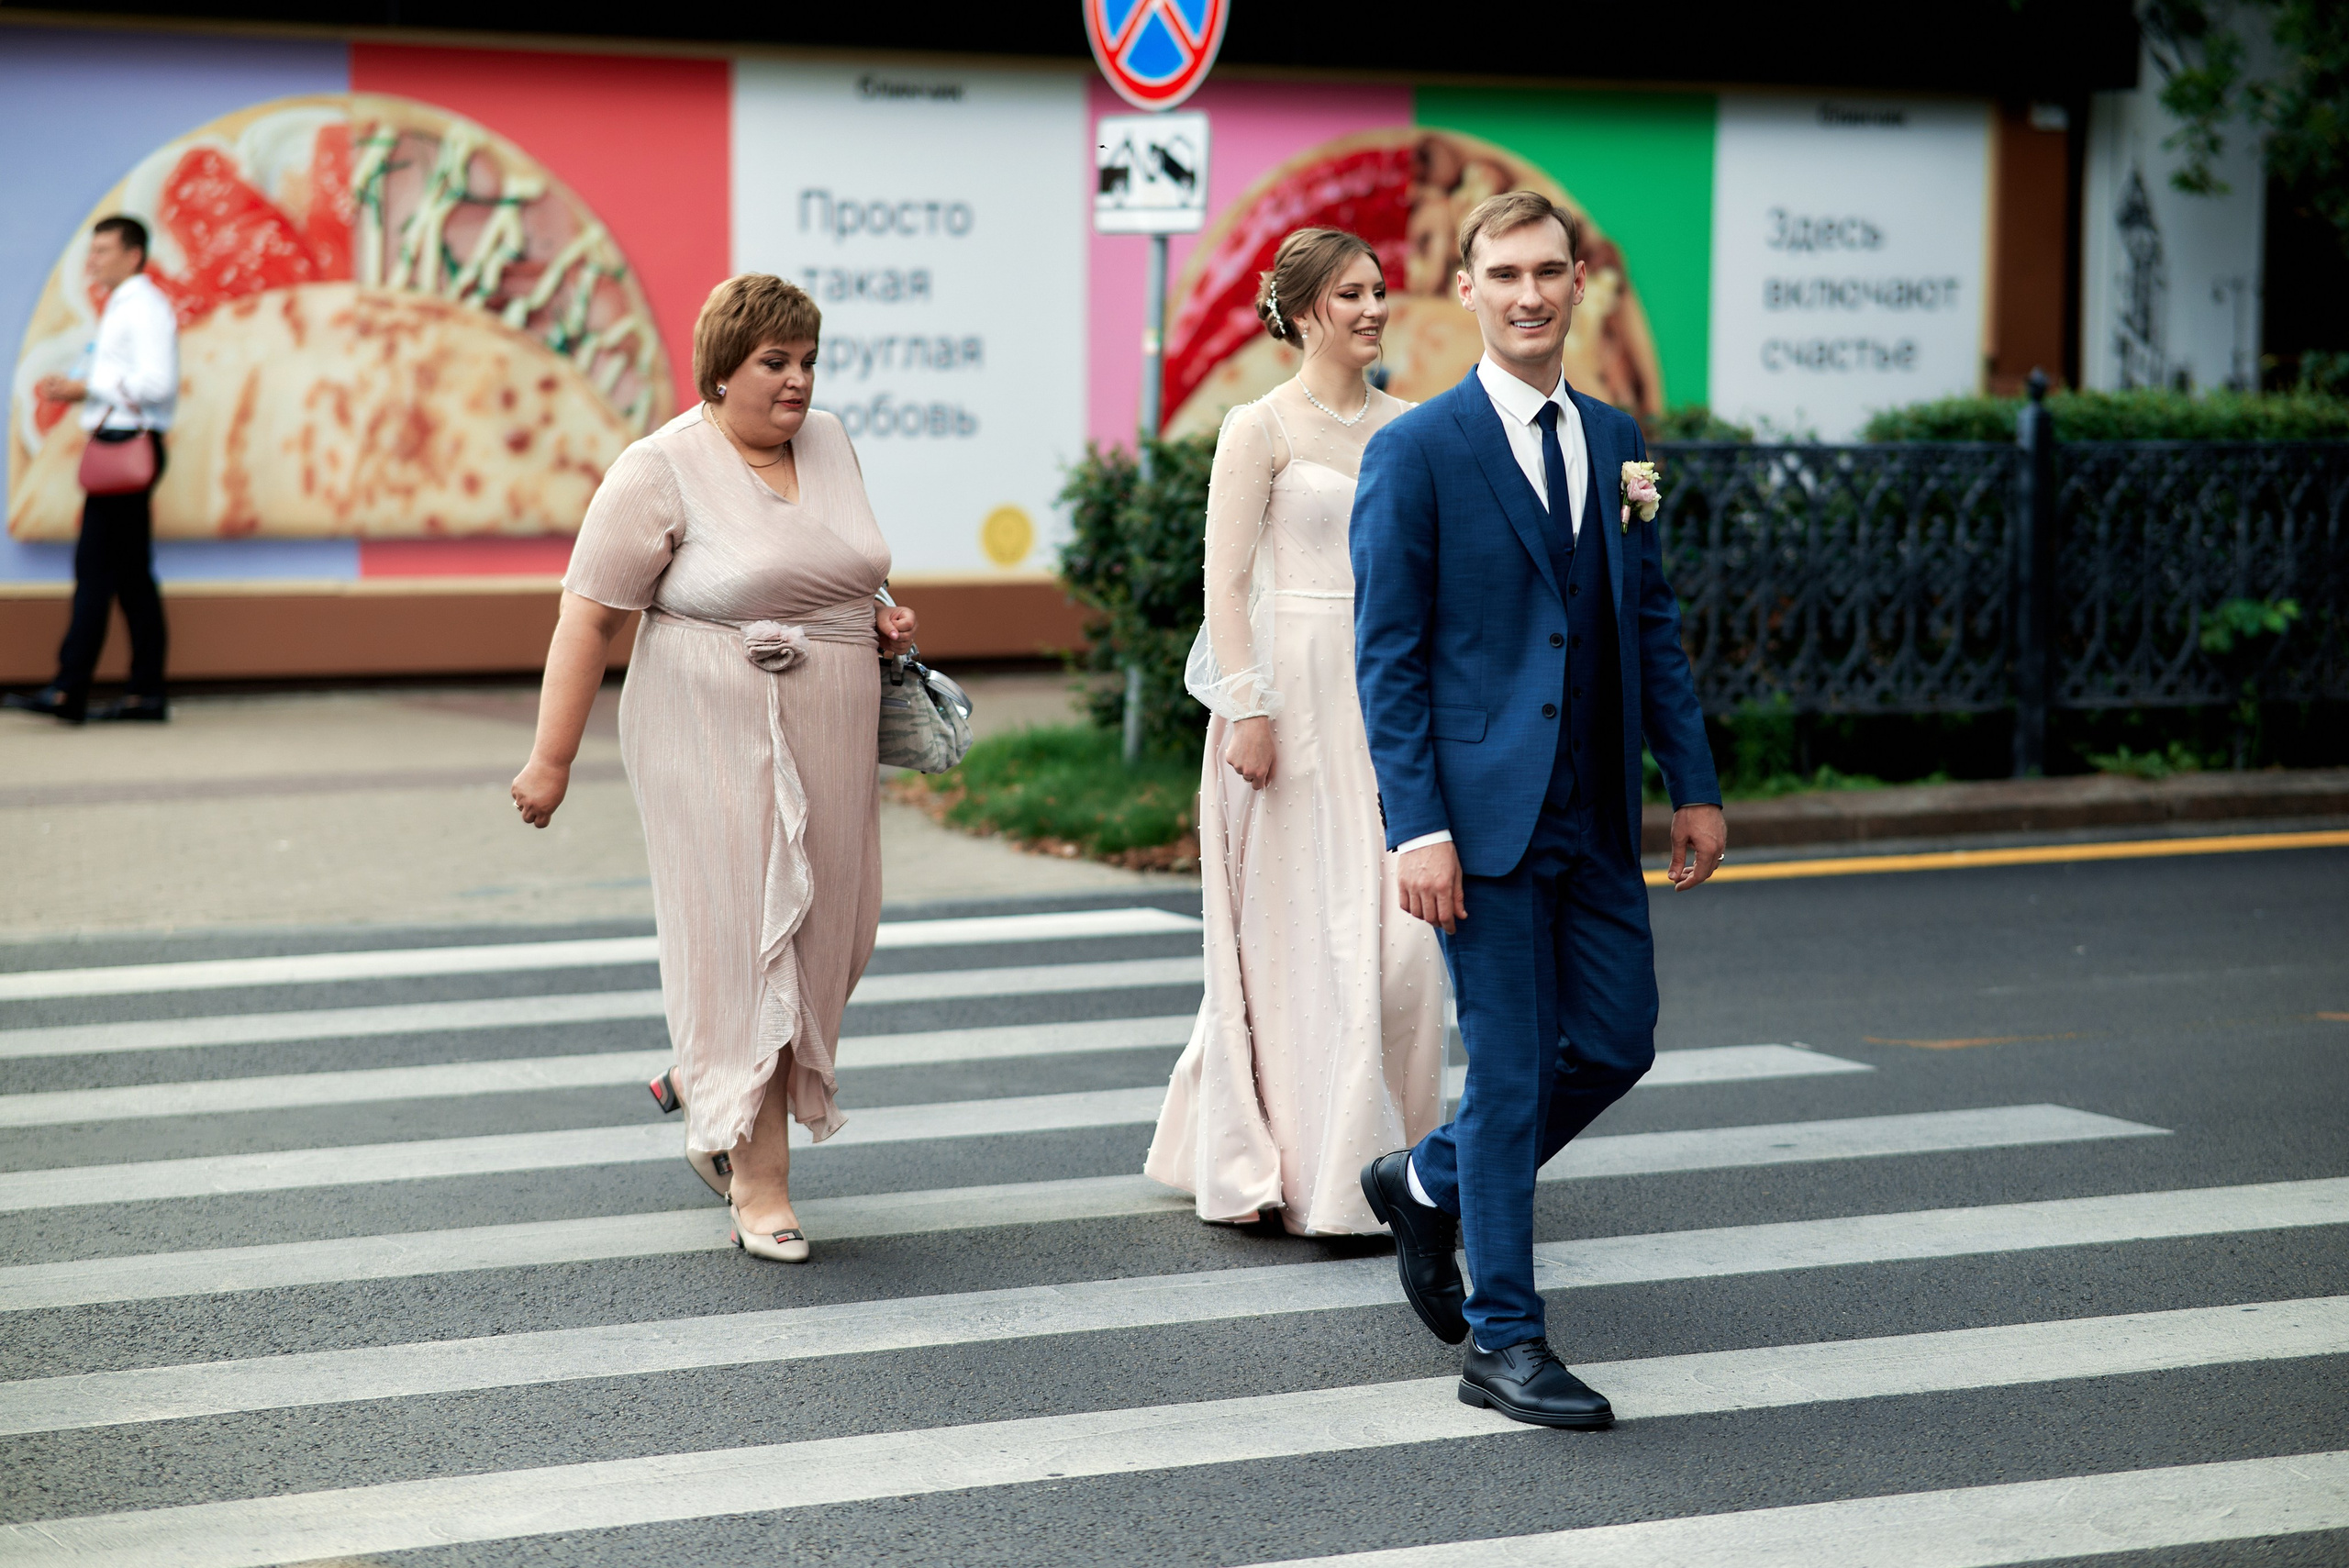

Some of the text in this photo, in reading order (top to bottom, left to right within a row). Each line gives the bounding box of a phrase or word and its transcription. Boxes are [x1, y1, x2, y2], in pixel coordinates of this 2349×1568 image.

[798, 188, 974, 243] Просто
[1765, 206, 1885, 254] Здесь
[801, 267, 931, 304] такая
[1763, 276, 1960, 310] включают
[818, 335, 984, 378] руглая
[1760, 337, 1918, 373] счастье
[811, 393, 978, 439] юбовь
